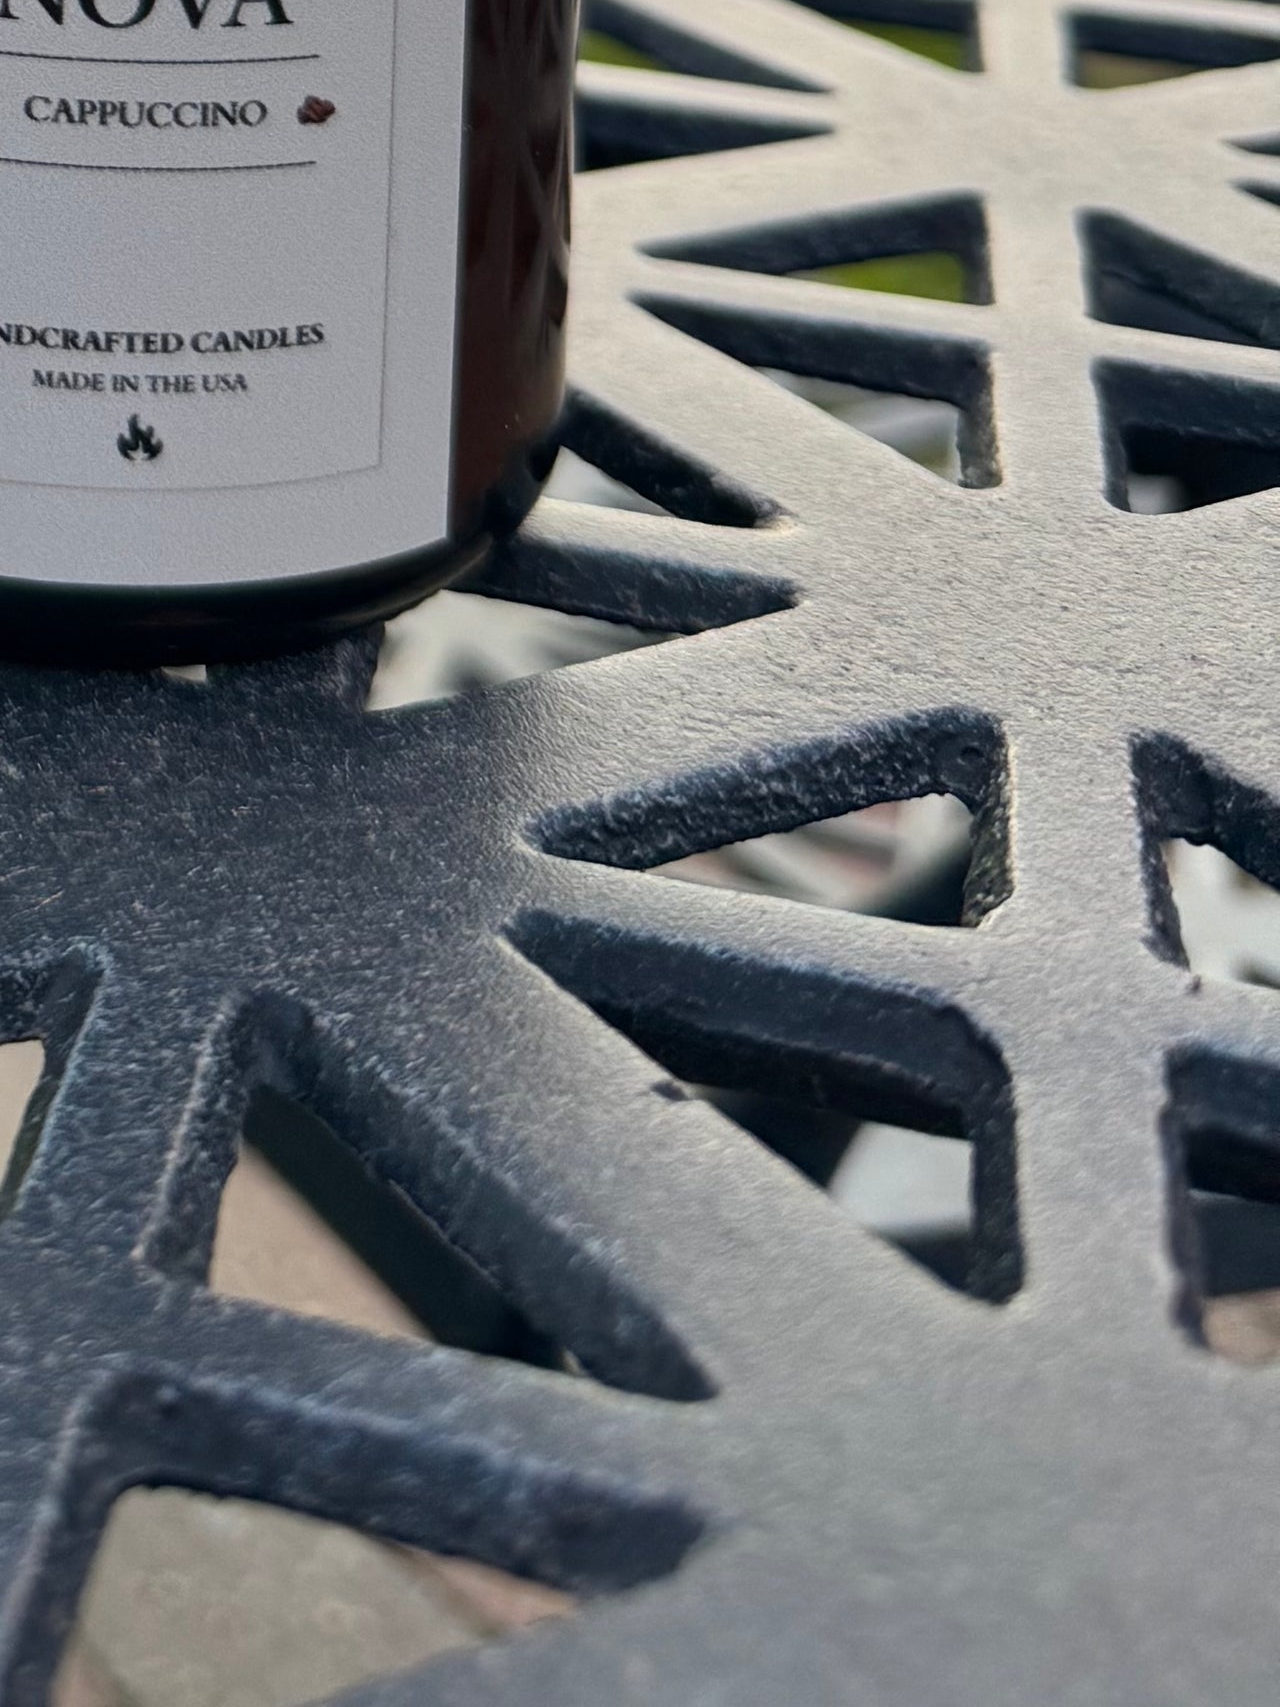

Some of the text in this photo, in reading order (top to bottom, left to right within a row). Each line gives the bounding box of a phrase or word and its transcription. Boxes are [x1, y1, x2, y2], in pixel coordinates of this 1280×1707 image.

[23, 94, 269, 129] CAPPUCCINO
[189, 322, 326, 355] CANDLES
[32, 368, 250, 395] MADE IN THE USA
